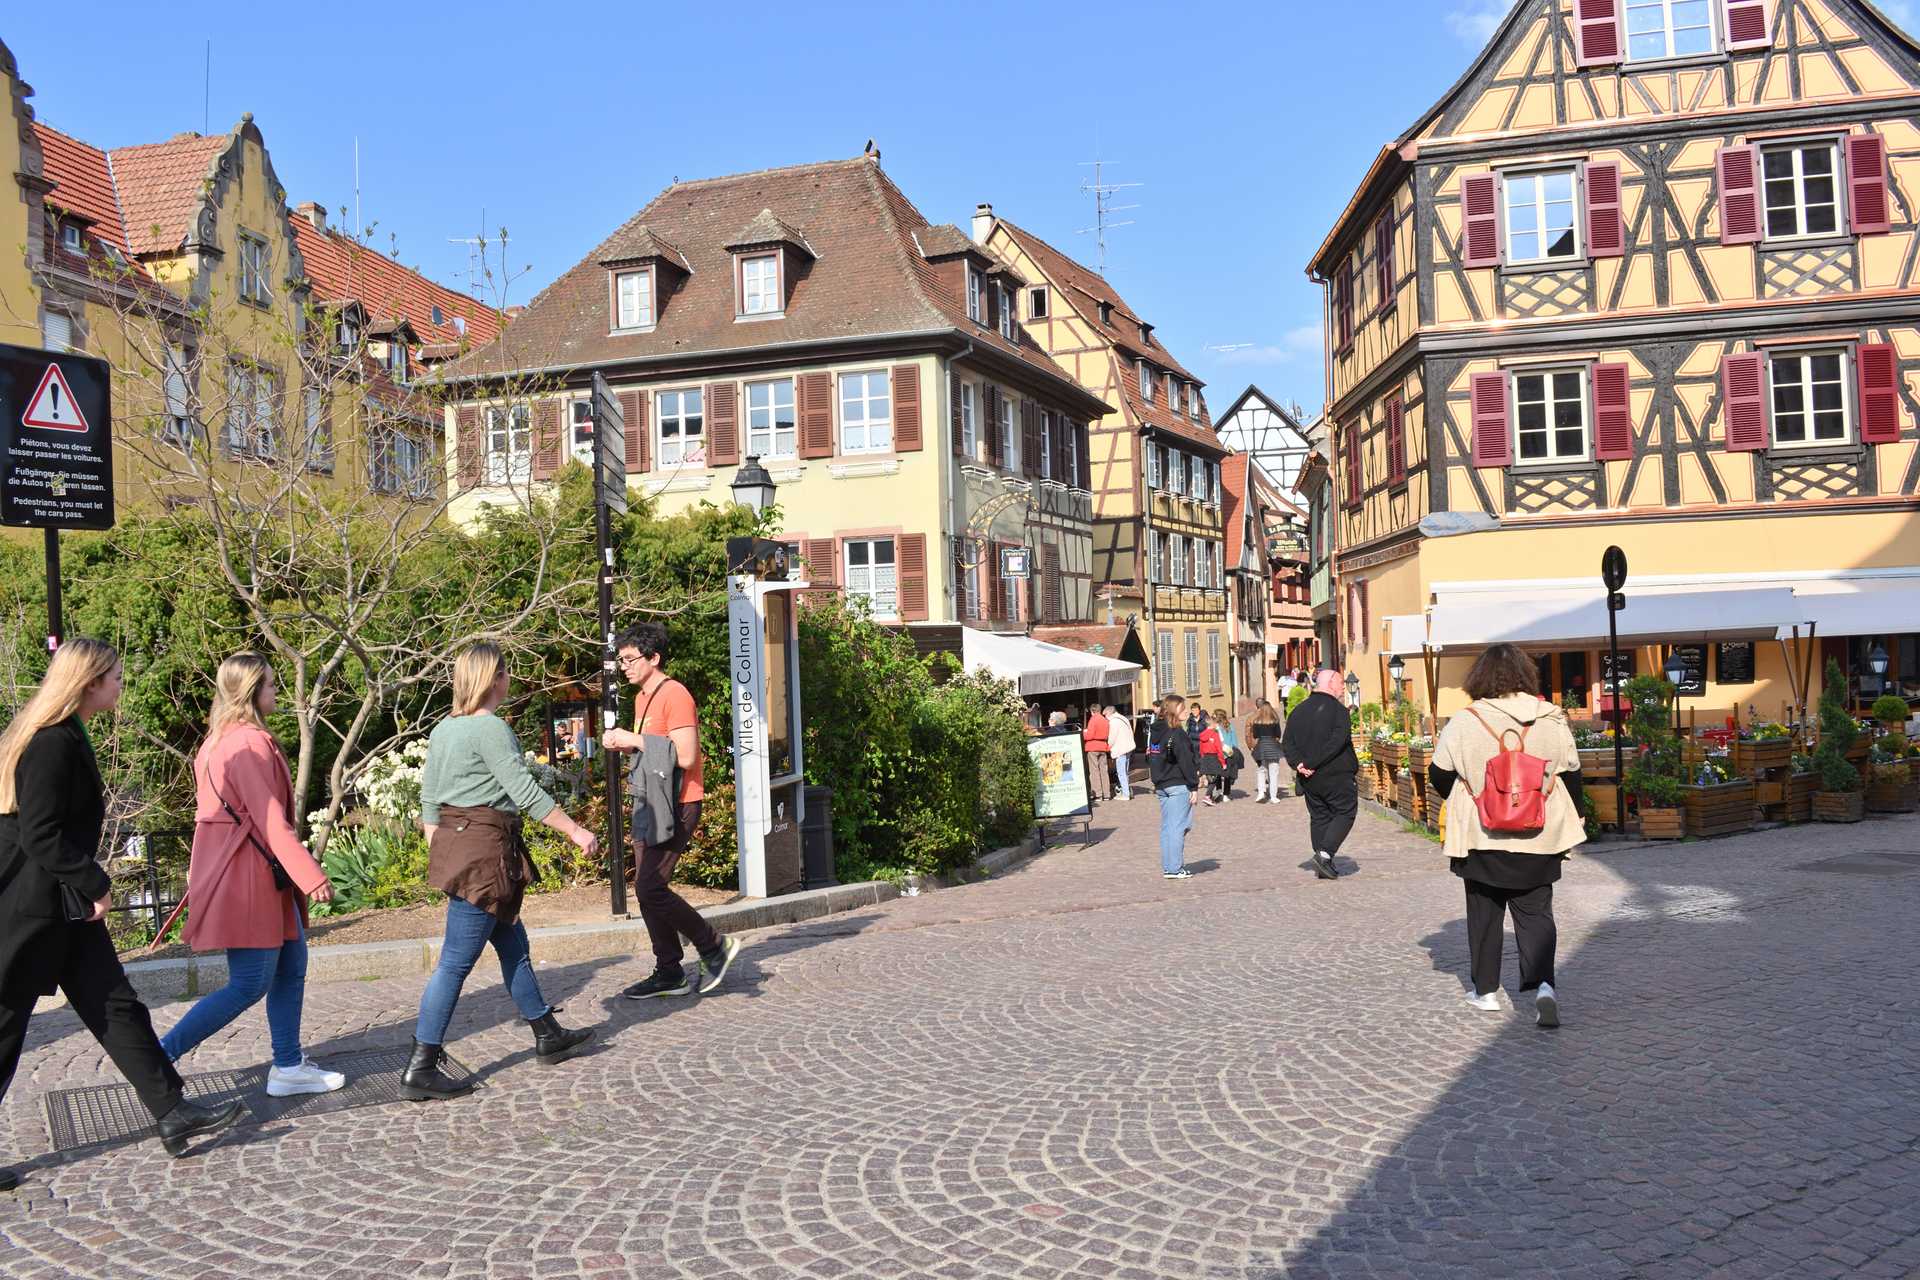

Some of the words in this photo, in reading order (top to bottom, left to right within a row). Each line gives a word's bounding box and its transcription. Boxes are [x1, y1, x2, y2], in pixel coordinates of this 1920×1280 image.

[20, 438, 50, 448] Piétons,
[52, 442, 70, 450] vous
[71, 444, 92, 452] devez
[8, 447, 33, 456] laisser
[35, 451, 60, 459] passer
[61, 452, 72, 460] les
[73, 454, 104, 463] voitures.
[8, 477, 20, 485] die
[22, 479, 44, 487] Autos
[81, 483, 106, 491] lassen.
[71, 473, 99, 481] müssen
[13, 497, 59, 508] Pedestrians,
[34, 508, 47, 516] the
[735, 618, 751, 684] Colmar
[737, 691, 752, 712] de
[738, 719, 753, 757] Ville
